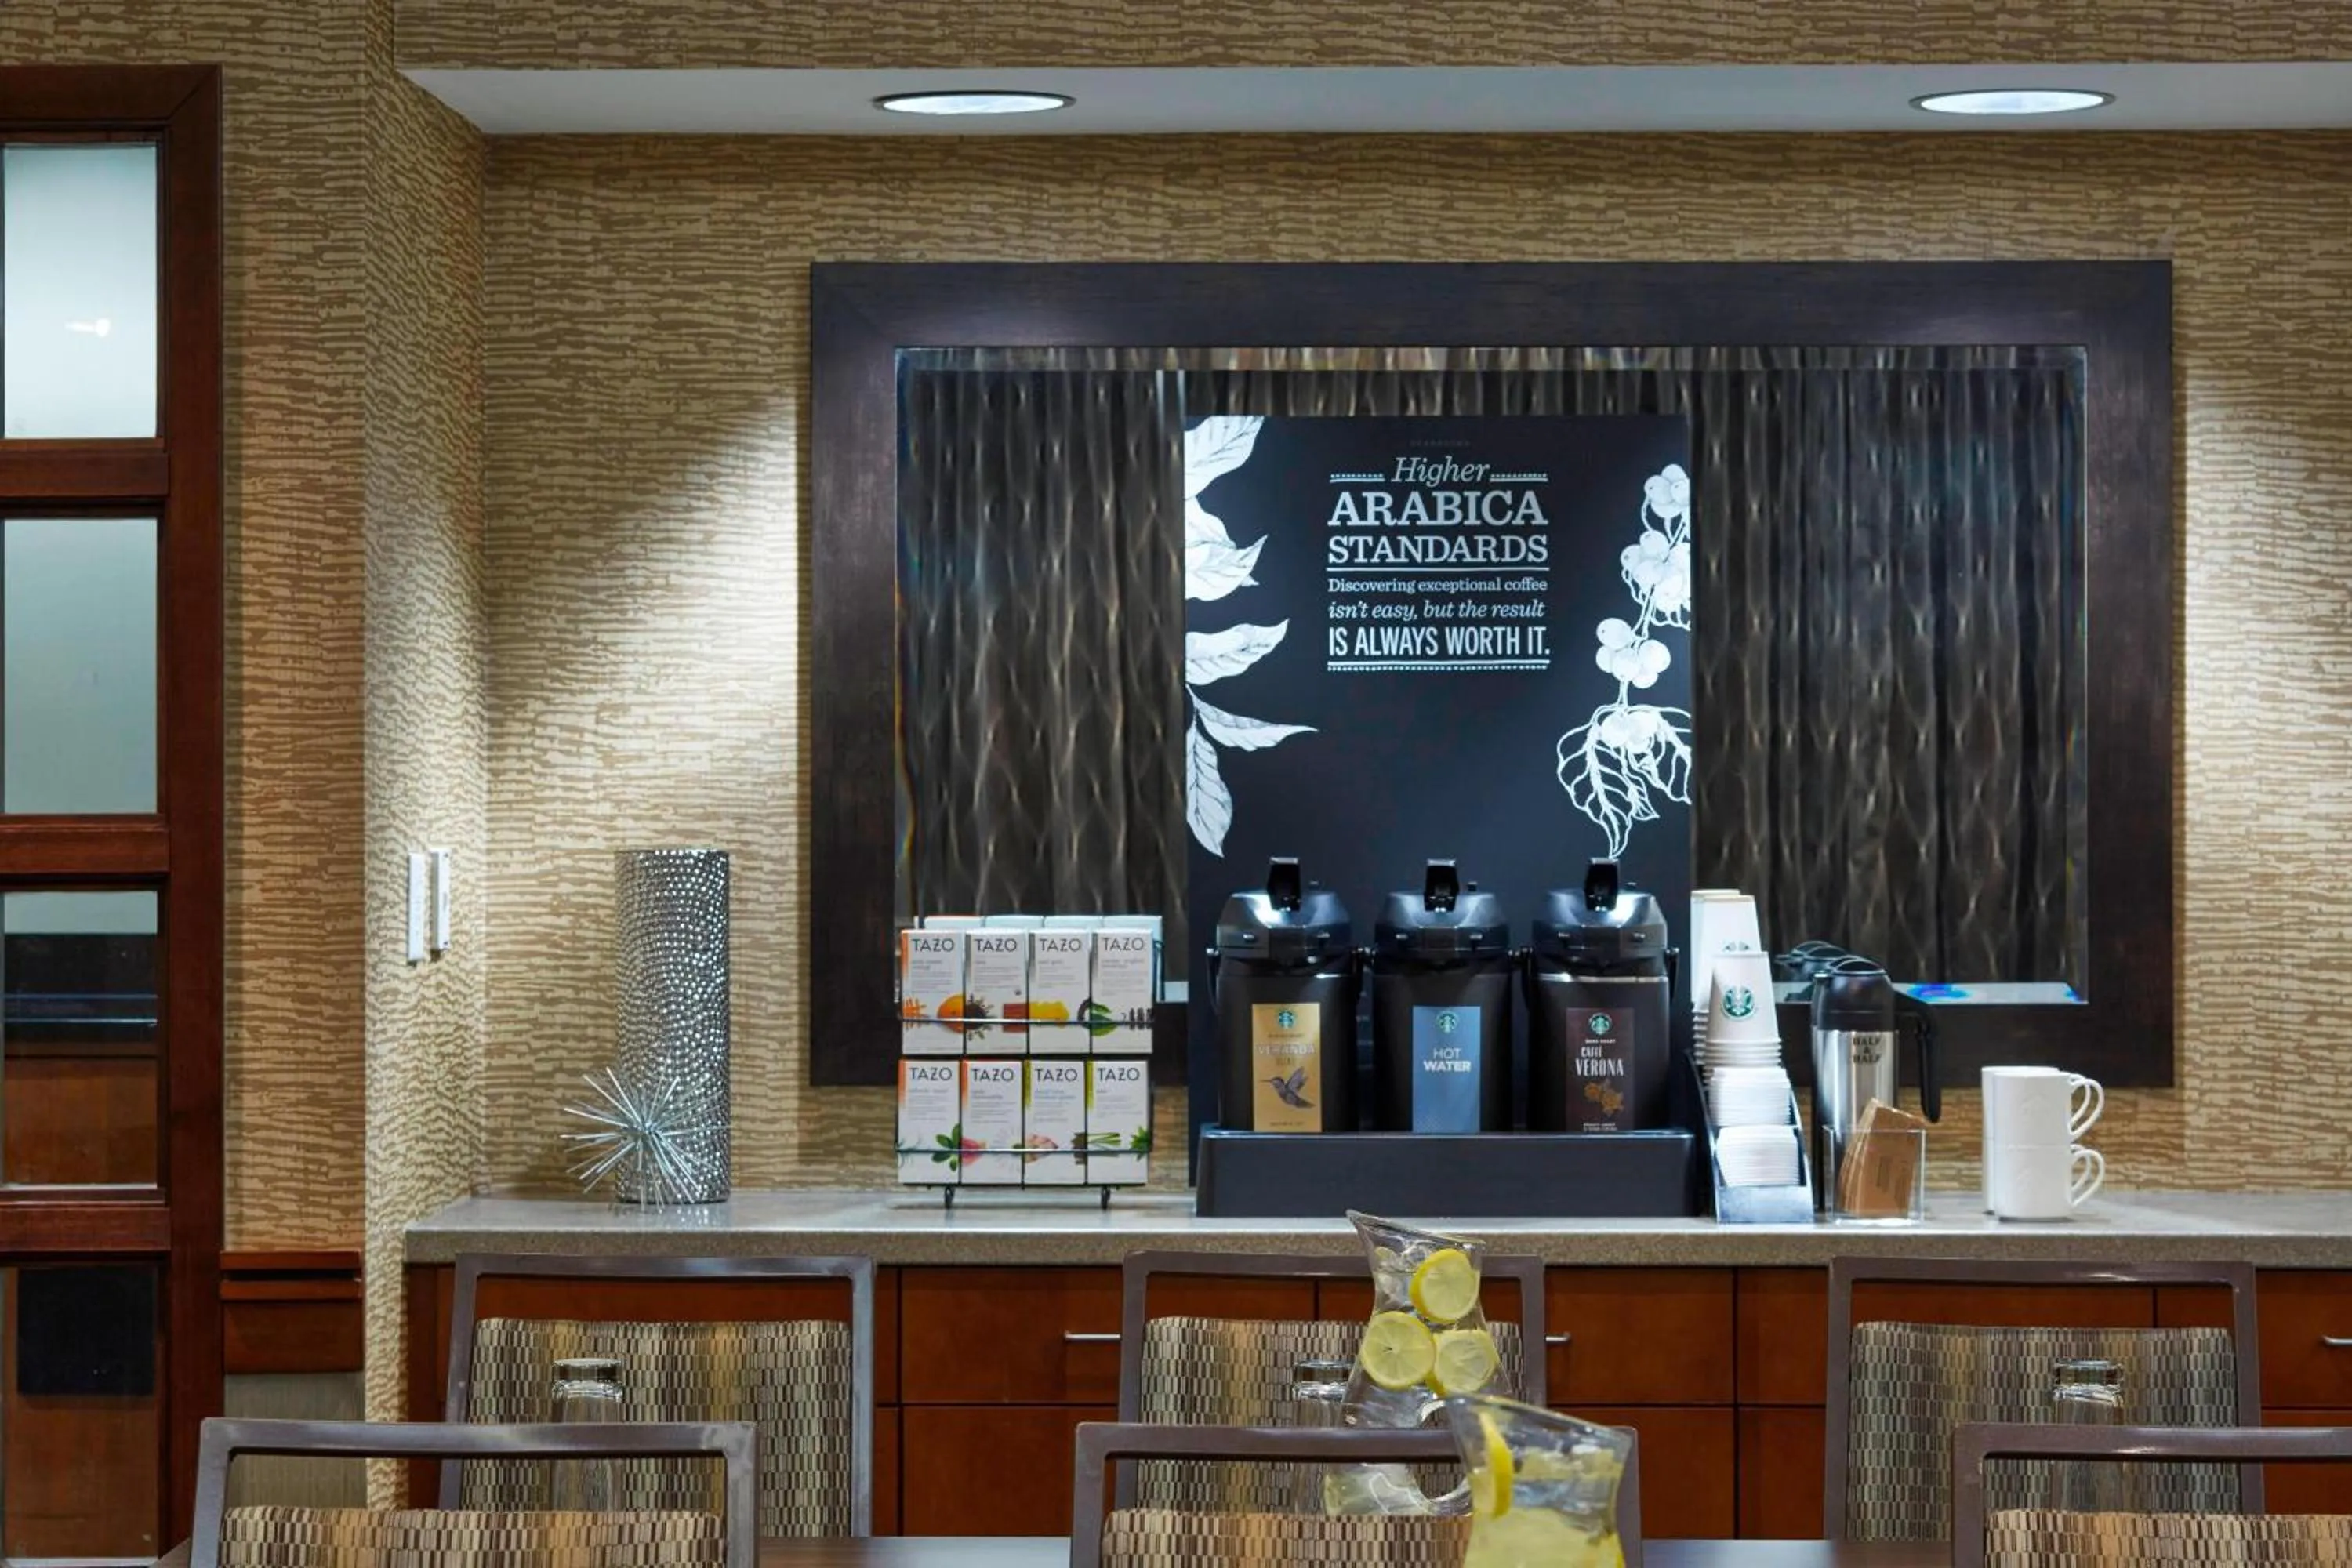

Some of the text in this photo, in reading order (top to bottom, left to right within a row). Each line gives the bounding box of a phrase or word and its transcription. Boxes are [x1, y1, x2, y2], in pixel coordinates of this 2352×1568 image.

[1391, 456, 1490, 487] Higher
[1327, 490, 1549, 526] ARABICA
[1328, 535, 1548, 564] STANDARDS
[1327, 577, 1548, 594] Discovering exceptional coffee
[1371, 604, 1418, 621] easy,
[1423, 600, 1454, 618] but
[1458, 600, 1487, 617] the
[1490, 599, 1545, 617] result
[1328, 626, 1551, 656] IS ALWAYS WORTH IT.
[911, 938, 955, 953] TAZO
[975, 938, 1018, 953] TAZO
[1039, 938, 1082, 952] TAZO
[1101, 936, 1145, 952] TAZO
[1433, 1048, 1462, 1058] HOT
[908, 1066, 953, 1081] TAZO
[971, 1067, 1014, 1082] TAZO
[1035, 1067, 1078, 1082] TAZO
[1098, 1066, 1141, 1082] TAZO
[1424, 1061, 1472, 1072] WATER
[1575, 1058, 1624, 1076] VERONA
